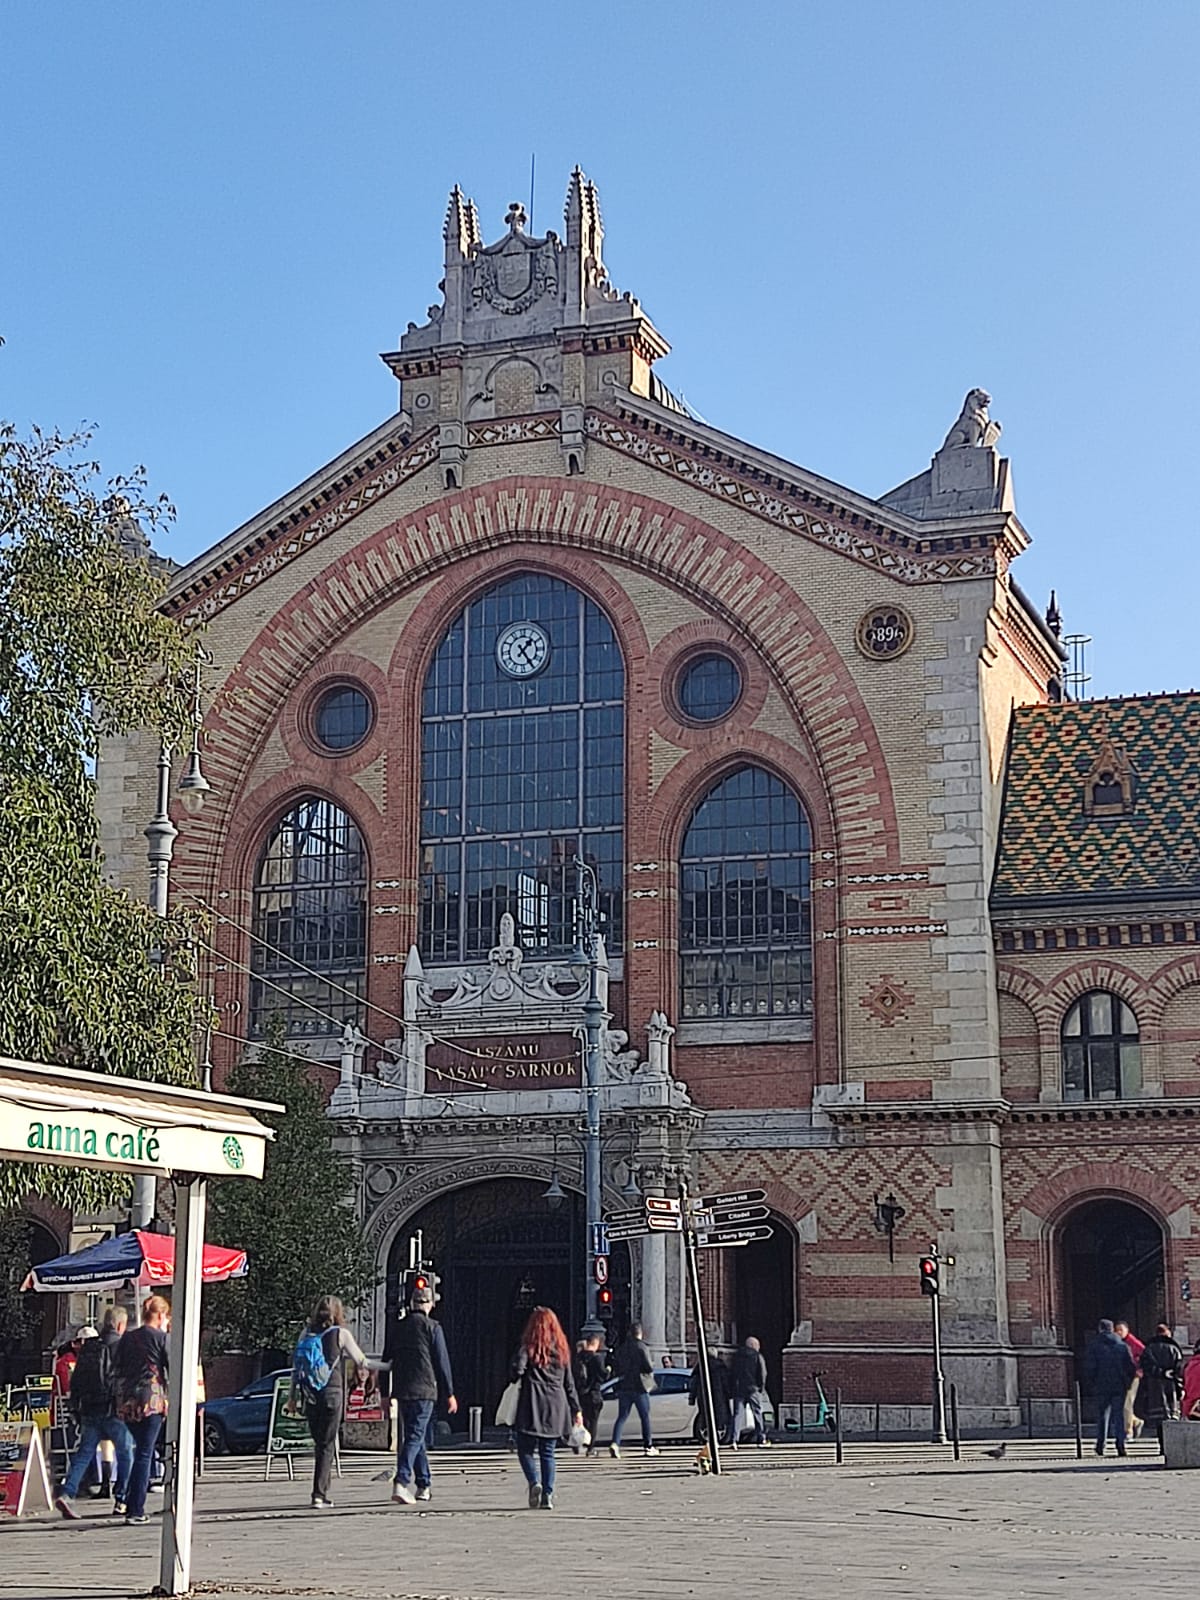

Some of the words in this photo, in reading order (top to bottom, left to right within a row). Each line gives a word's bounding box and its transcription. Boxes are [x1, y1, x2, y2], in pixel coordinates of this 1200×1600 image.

[27, 1121, 98, 1155] anna
[105, 1127, 161, 1162] café
[68, 1273, 94, 1282] TOURIST
[94, 1268, 136, 1279] INFORMATION
